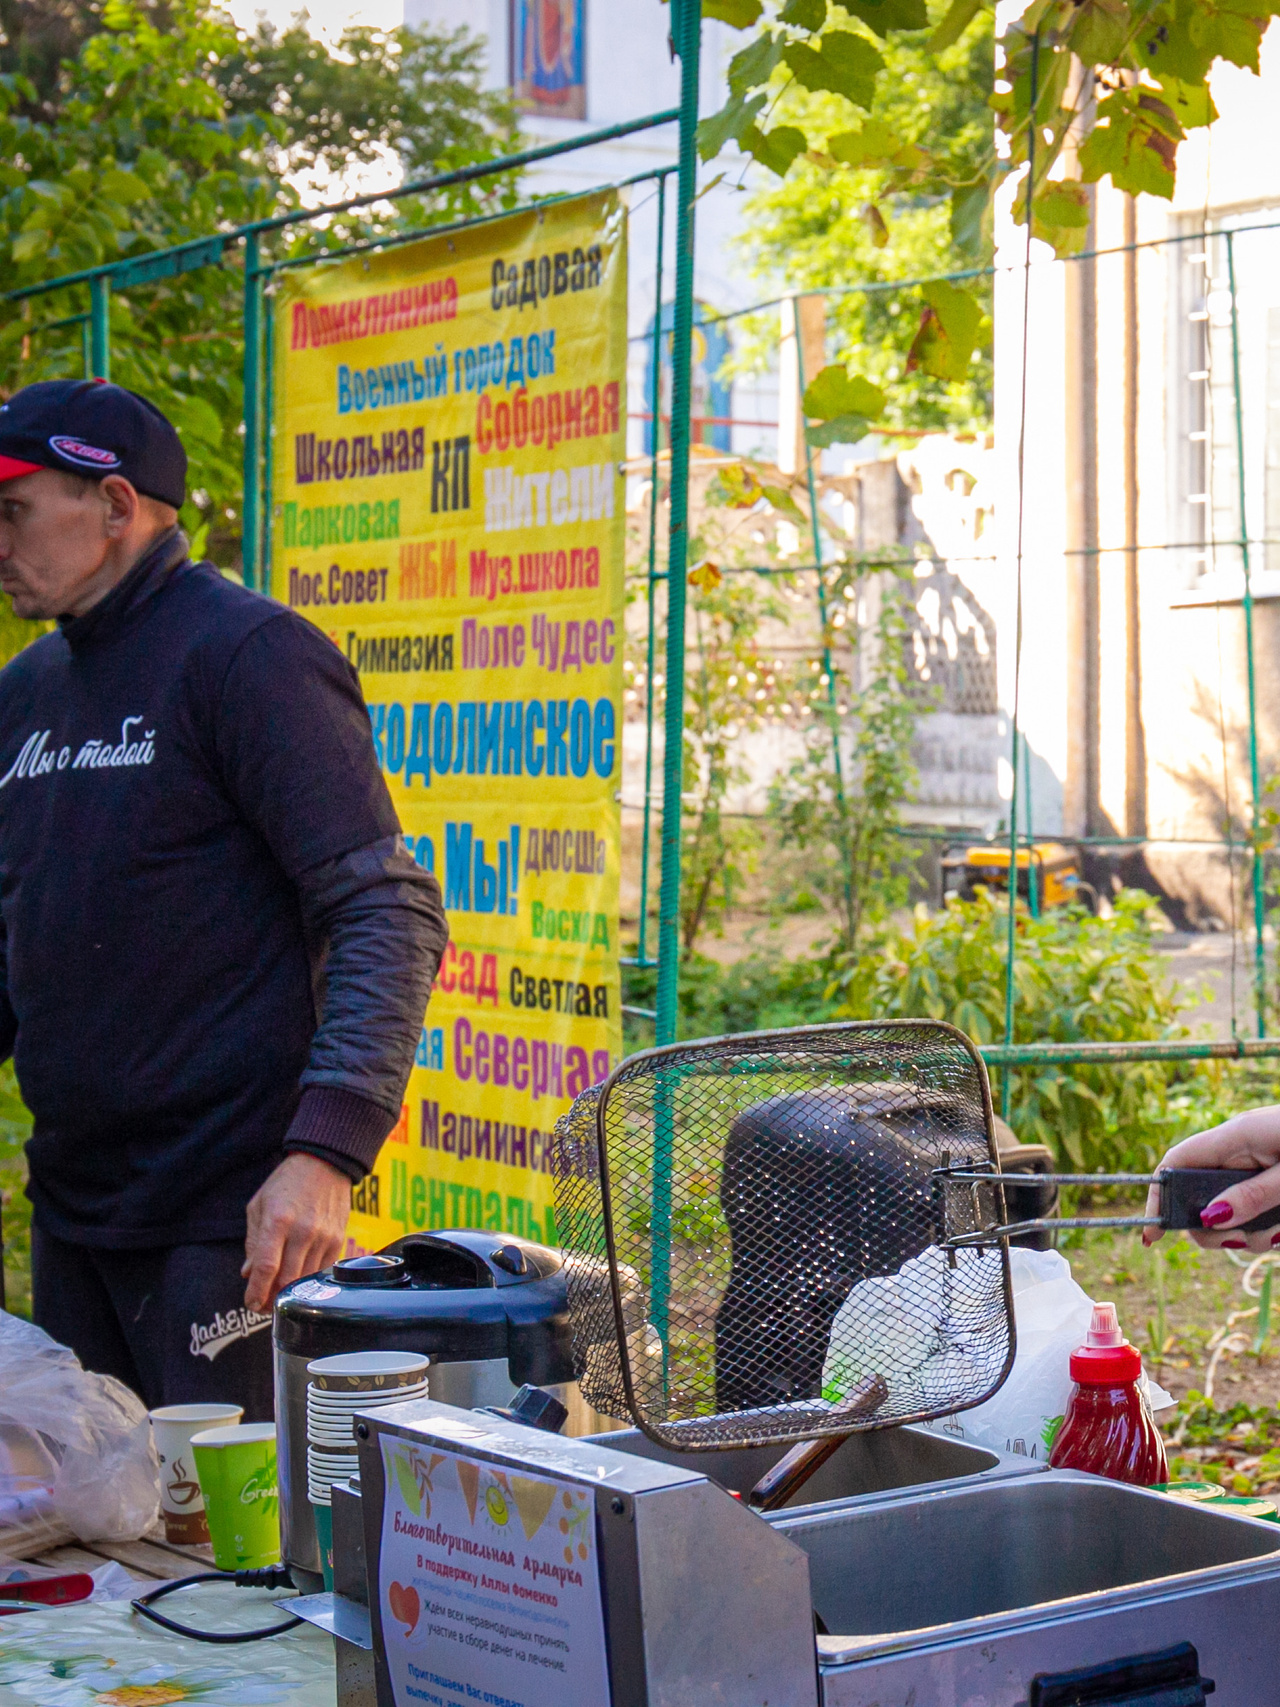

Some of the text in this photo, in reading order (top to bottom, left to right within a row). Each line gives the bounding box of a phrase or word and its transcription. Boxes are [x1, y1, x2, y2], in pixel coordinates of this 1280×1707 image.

[491, 243, 603, 312] Садовая
[290, 276, 459, 351] Поликлиника
[337, 328, 556, 415] Военный городок
[475, 381, 621, 456] Соборная
[295, 426, 426, 485] Школьная
[431, 435, 470, 514] КП
[283, 497, 401, 552] Парковая
[483, 462, 615, 533] Жители
[288, 564, 388, 607] Пос.Совет
[399, 538, 458, 602] ЖБИ
[468, 545, 600, 602] Муз.школа
[347, 631, 454, 673] Гимназия
[462, 612, 616, 674] Поле Чудес
[0, 715, 156, 788] Мы с тобой
[444, 821, 521, 916] Мы!
[531, 900, 610, 953] Восход
[509, 966, 609, 1019] Светлая
[453, 1016, 610, 1101] Северная
[393, 1510, 516, 1567] Благотворительная
[416, 1554, 424, 1568] В
[425, 1558, 478, 1588] поддержку
[480, 1573, 510, 1594] Аллы
[512, 1582, 558, 1608] Фоменко
[427, 1622, 458, 1641] участие
[459, 1632, 465, 1643] в
[465, 1633, 489, 1651] сборе
[490, 1642, 513, 1658] денег
[515, 1649, 526, 1661] на
[447, 1608, 464, 1622] всех
[534, 1633, 570, 1653] принять
[408, 1662, 464, 1693] Приглашаем
[466, 1683, 482, 1700] Вас
[483, 1691, 525, 1707] отведа
